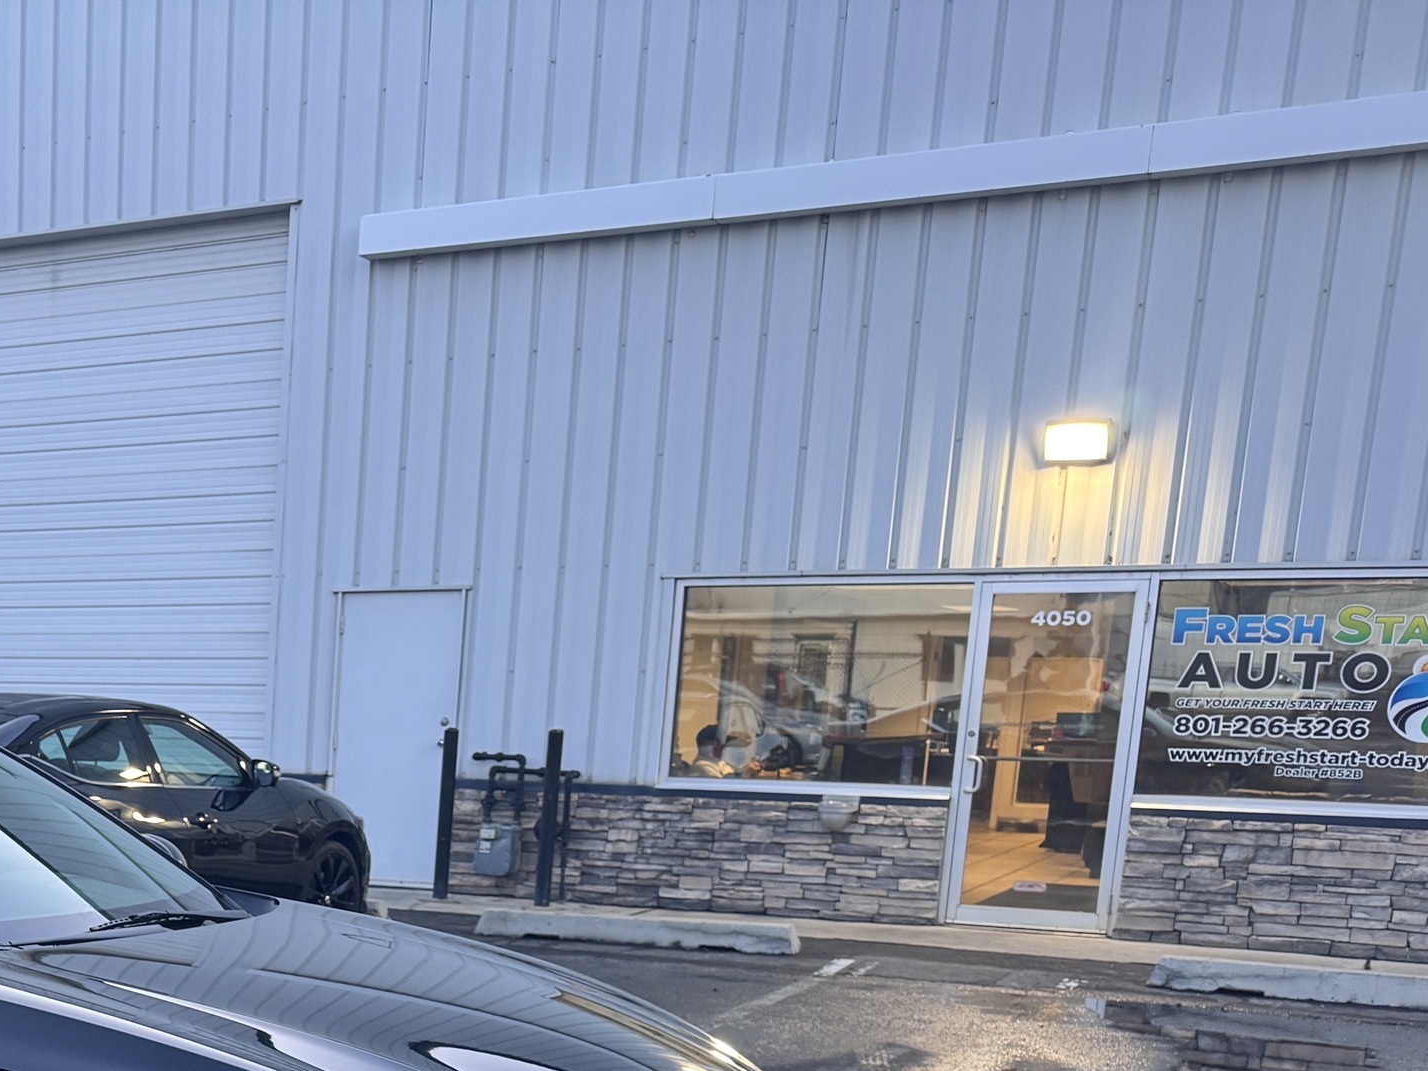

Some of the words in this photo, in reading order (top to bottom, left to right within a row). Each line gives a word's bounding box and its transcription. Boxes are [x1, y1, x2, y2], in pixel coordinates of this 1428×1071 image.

[1030, 610, 1092, 627] 4050
[1170, 607, 1326, 645] FRESH
[1174, 650, 1392, 694] AUTO
[1175, 697, 1202, 708] GET
[1204, 697, 1240, 709] YOUR
[1242, 698, 1286, 710] FRESH
[1287, 699, 1332, 711] START
[1332, 700, 1377, 712] HERE!
[1173, 714, 1370, 740] 801-266-3266
[1274, 766, 1318, 778] Dealer
